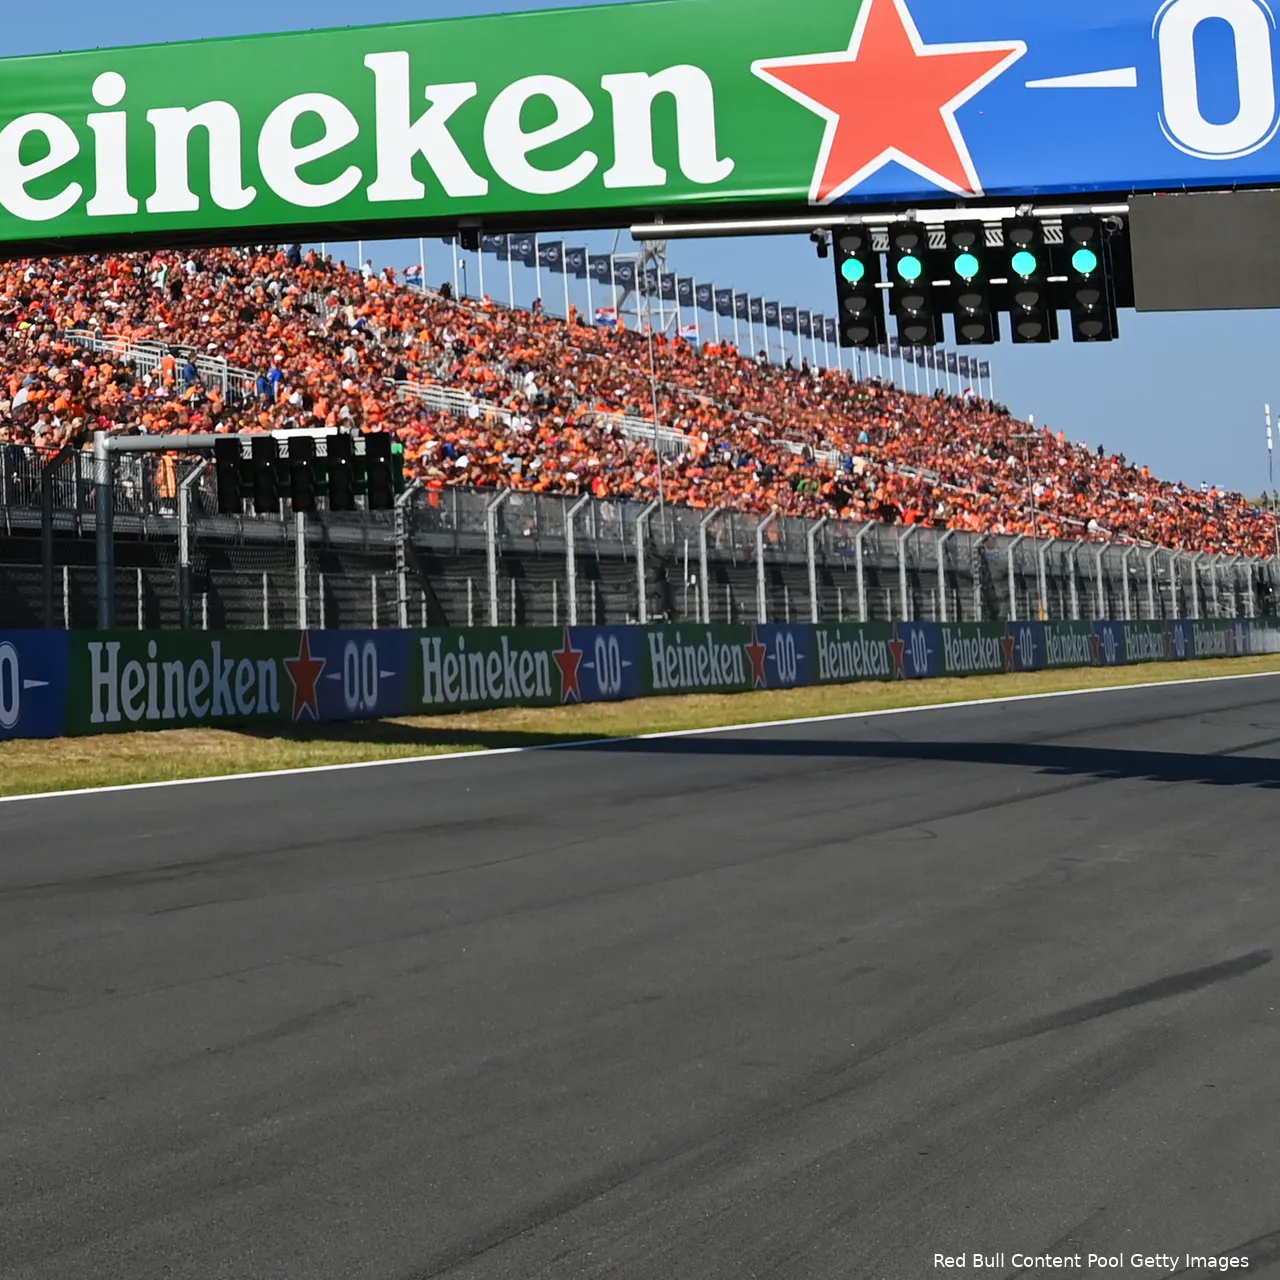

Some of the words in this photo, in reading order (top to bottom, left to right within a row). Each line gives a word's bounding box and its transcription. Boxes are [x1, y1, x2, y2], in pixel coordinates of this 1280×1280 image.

[421, 635, 552, 704] Heineken
[594, 634, 622, 696] 0.0
[648, 631, 745, 688] Heineken
[775, 631, 797, 682] 0.0
[816, 629, 891, 680] Heineken
[942, 627, 1002, 672] Heineken
[1044, 625, 1091, 665] Heineken
[88, 640, 280, 723] Heineken
[342, 639, 379, 712] 0.0
